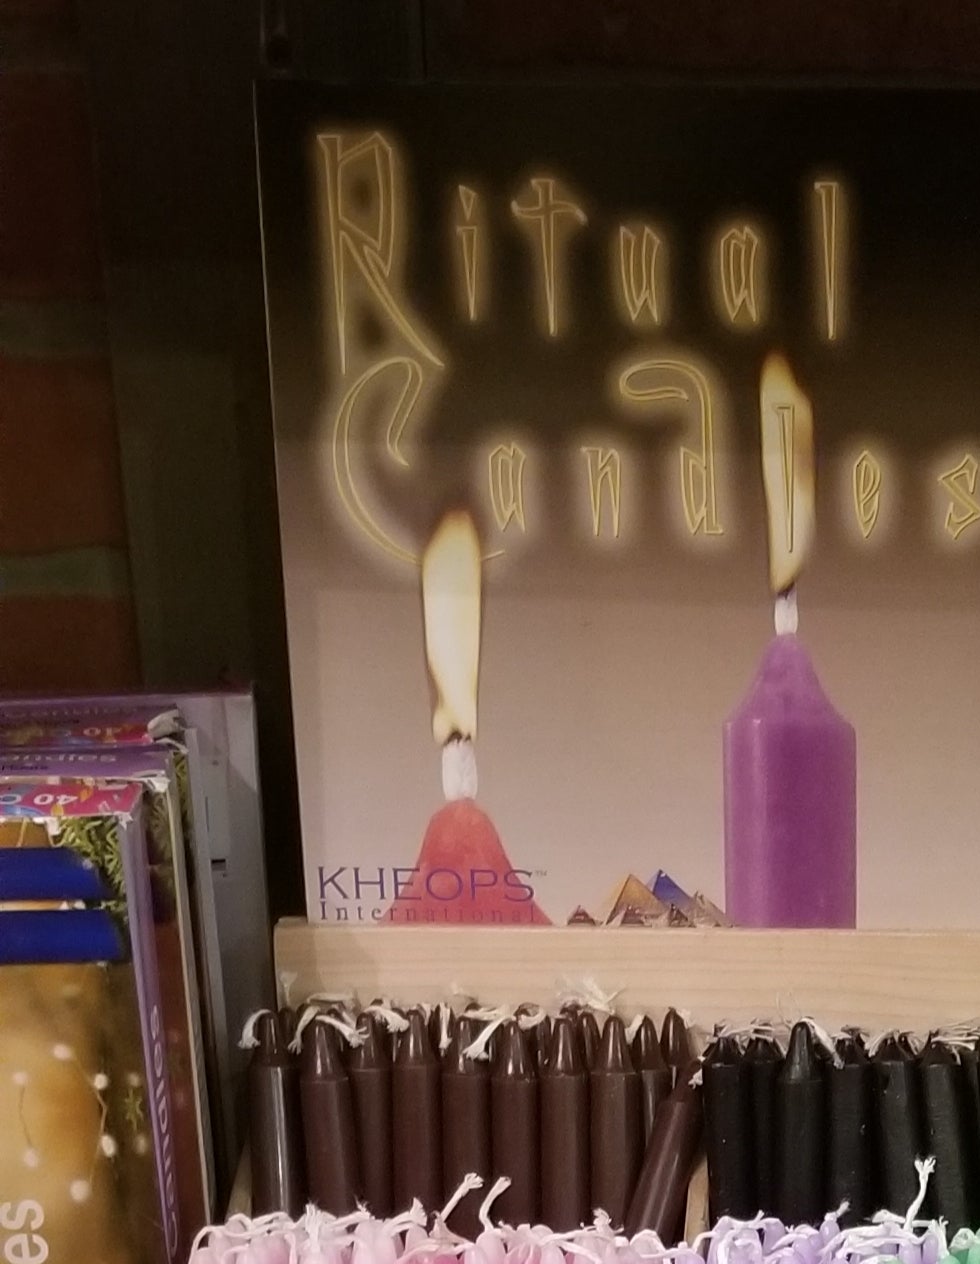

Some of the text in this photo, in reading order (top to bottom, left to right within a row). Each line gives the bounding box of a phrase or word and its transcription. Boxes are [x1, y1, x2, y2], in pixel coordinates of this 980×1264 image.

[316, 131, 840, 375] Ritual
[318, 866, 535, 901] KHEOPS
[319, 901, 536, 923] International
